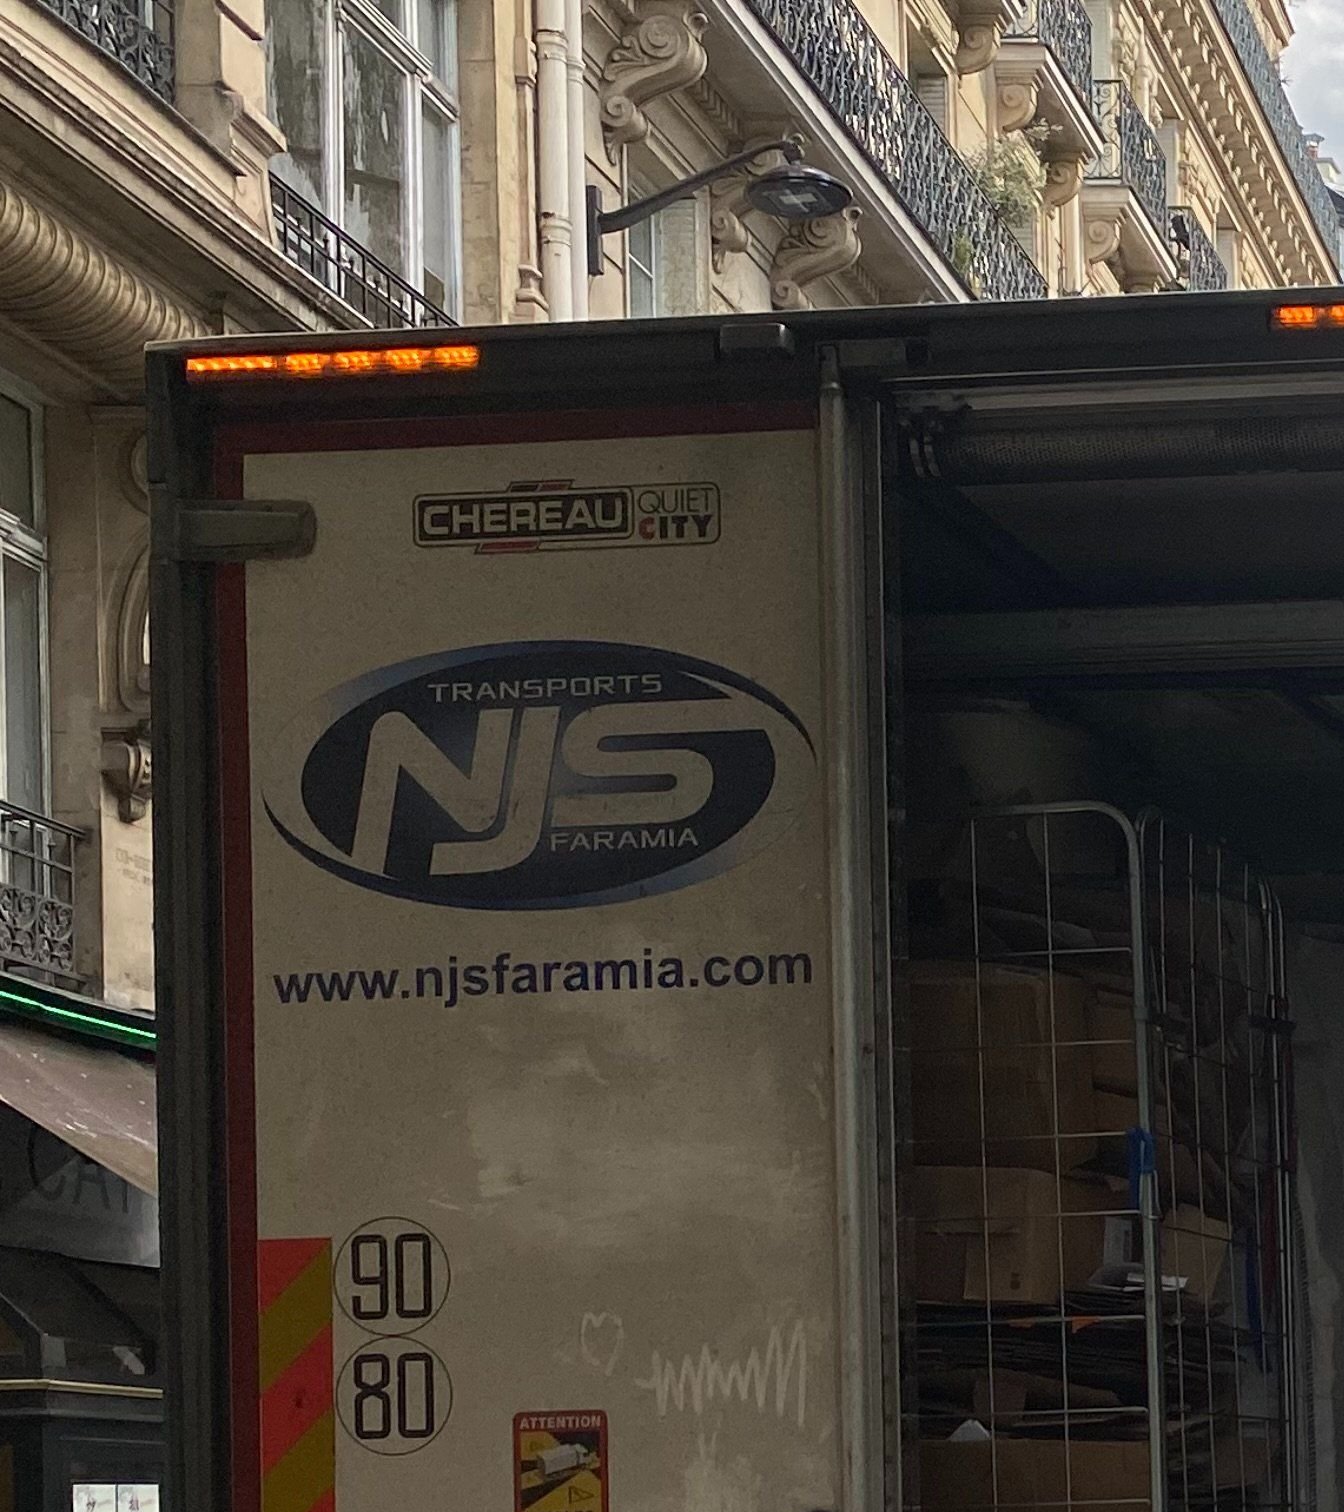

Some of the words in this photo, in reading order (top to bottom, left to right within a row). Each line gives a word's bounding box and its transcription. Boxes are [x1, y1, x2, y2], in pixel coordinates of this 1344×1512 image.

[422, 498, 624, 536] CHEREAU
[638, 487, 713, 515] QUIET
[638, 513, 713, 541] CITY
[428, 673, 664, 703] TRANSPORTS
[351, 698, 768, 877] NJS
[549, 827, 700, 853] FARAMIA
[272, 946, 813, 1009] www.njsfaramia.com
[351, 1232, 432, 1321] 90
[353, 1352, 434, 1440] 80
[519, 1415, 602, 1431] ATTENTION
